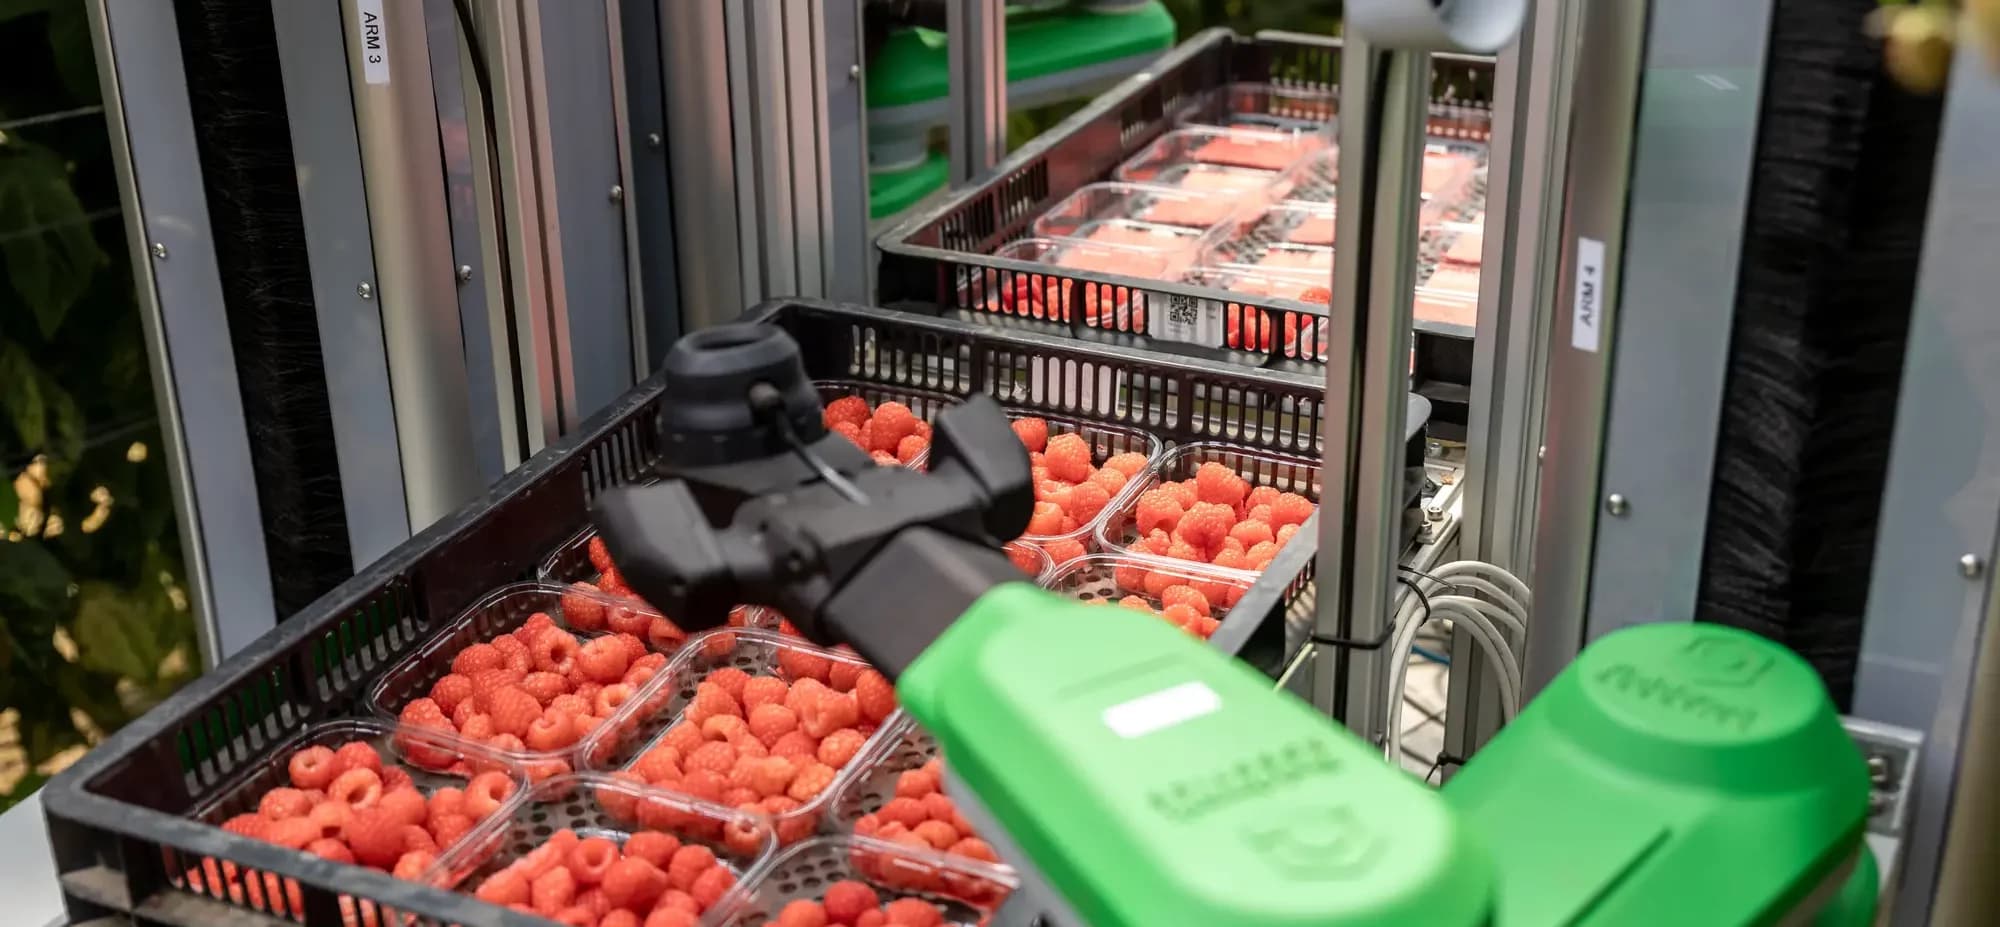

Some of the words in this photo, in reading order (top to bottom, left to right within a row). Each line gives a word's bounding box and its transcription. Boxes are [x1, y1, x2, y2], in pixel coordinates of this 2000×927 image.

[364, 12, 380, 49] ARM
[368, 55, 382, 64] 3
[1583, 265, 1596, 276] 4
[1579, 281, 1594, 328] ARM
